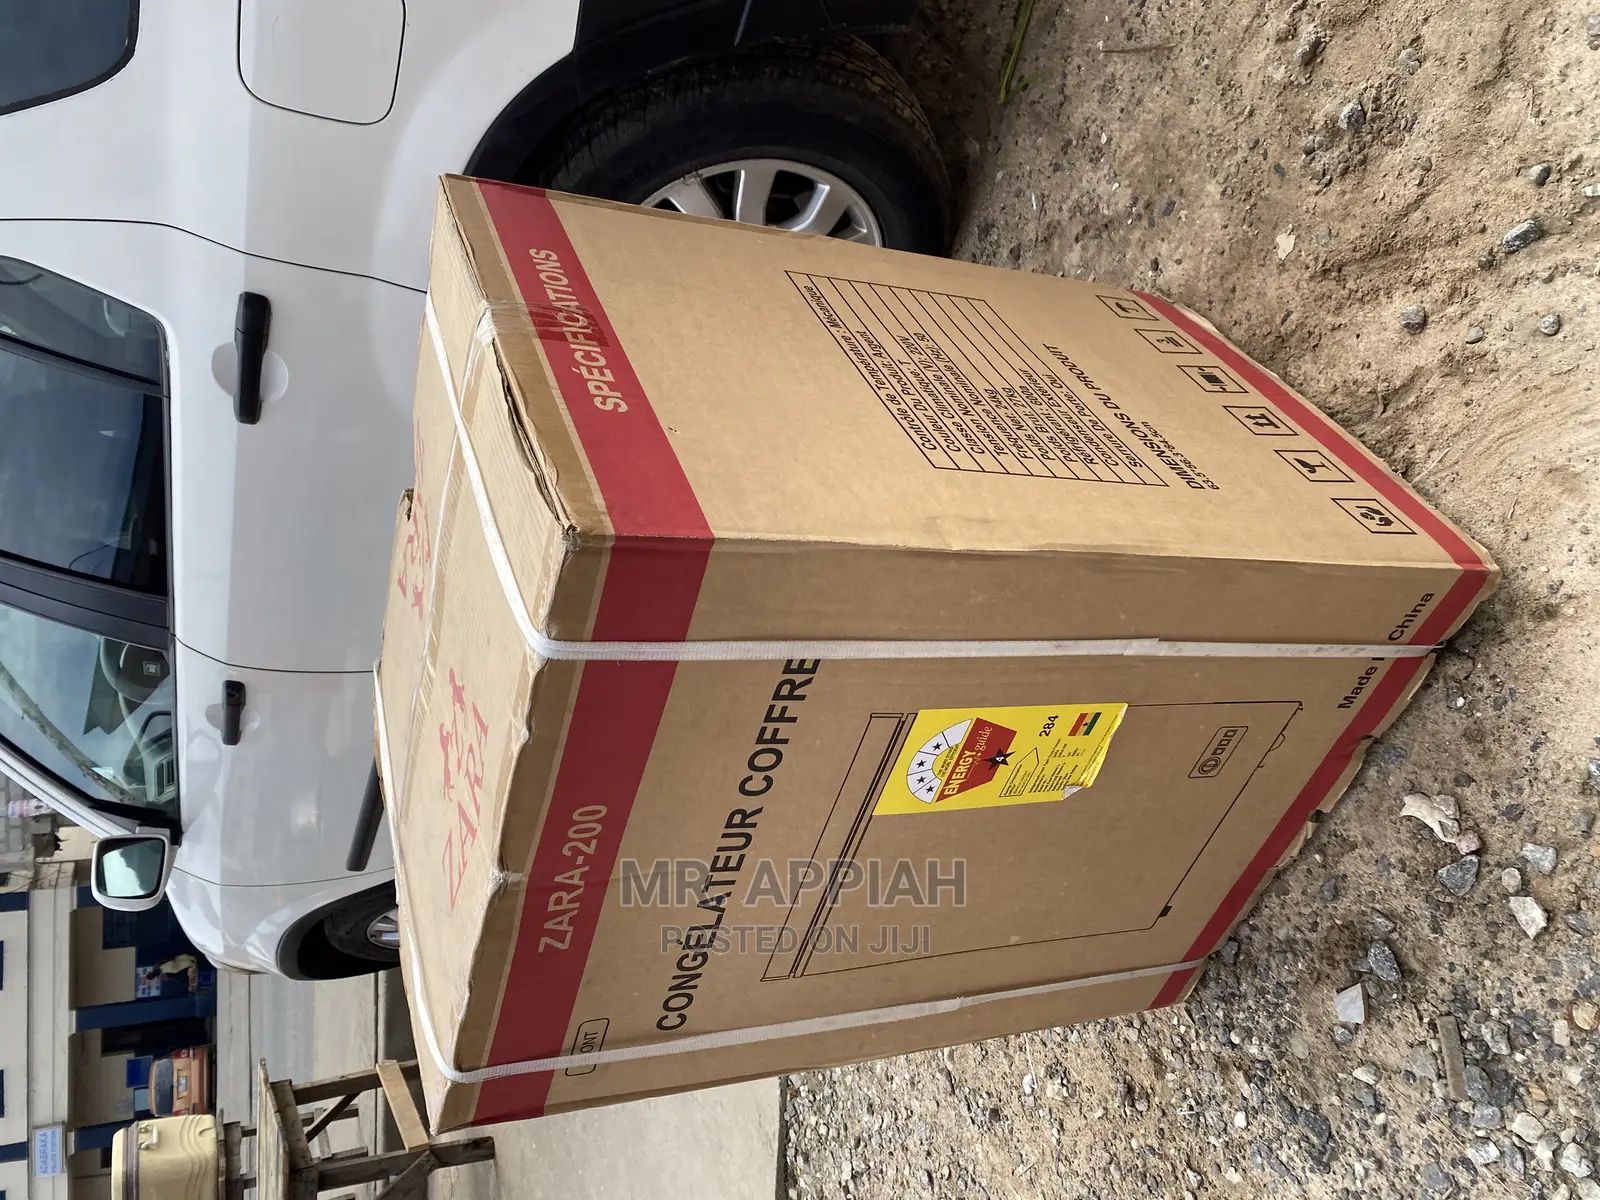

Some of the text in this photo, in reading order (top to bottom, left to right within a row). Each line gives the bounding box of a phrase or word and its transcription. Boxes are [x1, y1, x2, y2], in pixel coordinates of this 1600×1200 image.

[803, 285, 842, 328] Mécanique
[529, 248, 629, 413] SPÉCIFICATIONS
[897, 335, 923, 356] 220V
[913, 332, 929, 343] 50
[841, 335, 890, 391] Température
[1041, 374, 1063, 389] Oui
[855, 330, 962, 452] Couleur Du Produit: Argent
[886, 393, 902, 406] de
[933, 373, 974, 417] Nominale
[944, 363, 986, 407] Nominale
[984, 388, 1009, 411] 24kg
[1001, 386, 1025, 409] 27kg
[1018, 385, 1043, 406] 600a
[897, 407, 937, 451] Contrôle
[952, 421, 985, 455] Classe
[970, 417, 1009, 456] Tension
[982, 408, 1034, 460] Fréquence
[1018, 367, 1120, 467] Condenseur Extérieur
[1042, 343, 1206, 490] DIMENSIONS DU PRODUIT
[1089, 419, 1105, 433] De
[1024, 433, 1056, 461] Poids
[1047, 435, 1078, 463] Poids
[1105, 433, 1143, 468] Serrure
[1337, 666, 1378, 709] Made
[1387, 593, 1436, 642] China
[1038, 714, 1060, 738] 284
[943, 726, 993, 796] ENERGY guide
[442, 700, 489, 911] ZARA
[655, 658, 822, 1031] CONGÉLATEUR COFFRE
[538, 804, 608, 953] ZARA-200
